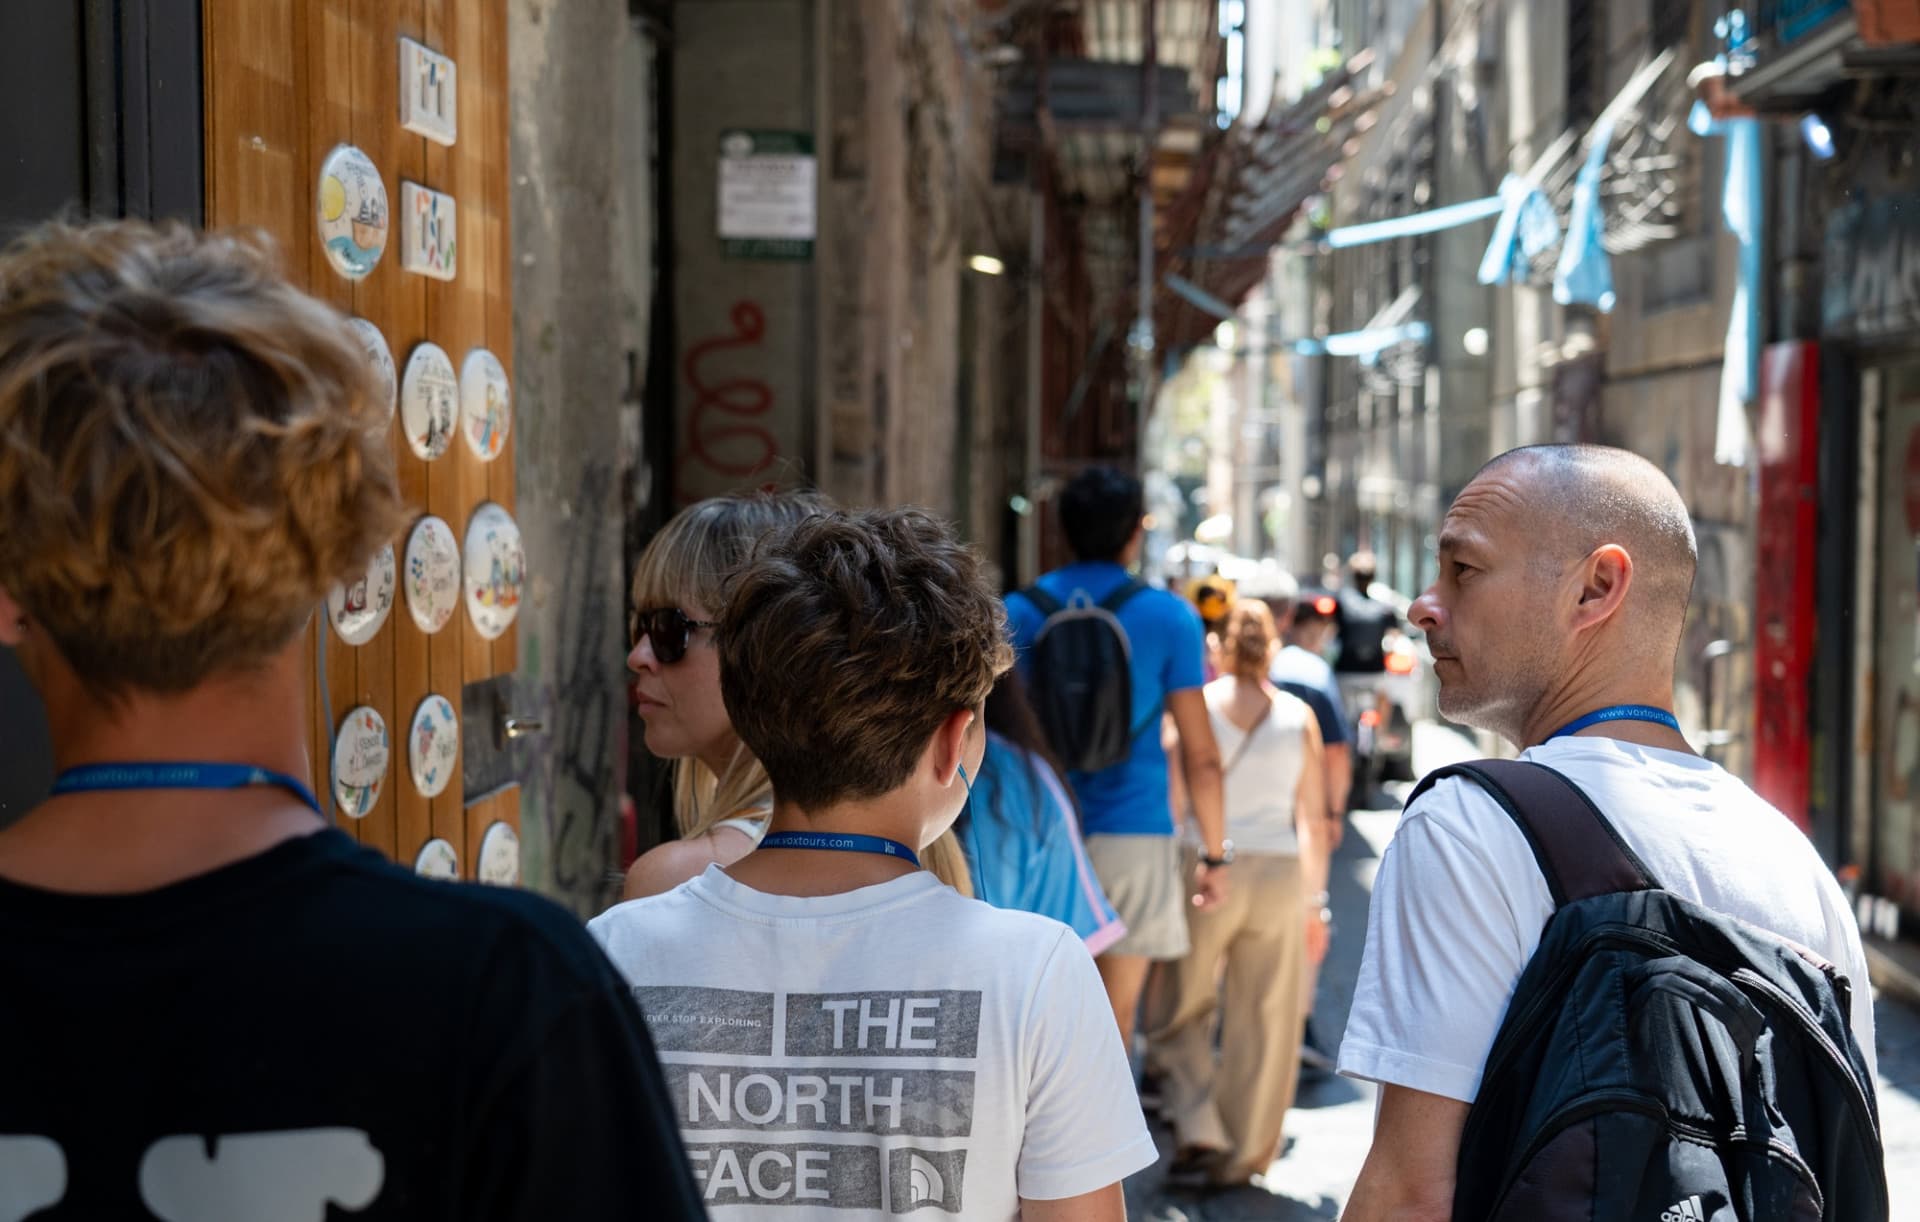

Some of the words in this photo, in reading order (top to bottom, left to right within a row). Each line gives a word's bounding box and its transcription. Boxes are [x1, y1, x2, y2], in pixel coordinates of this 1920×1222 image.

[642, 1014, 669, 1023] EVER
[672, 1014, 697, 1024] STOP
[700, 1016, 762, 1028] EXPLORING
[822, 998, 941, 1050] THE
[688, 1072, 903, 1129] NORTH
